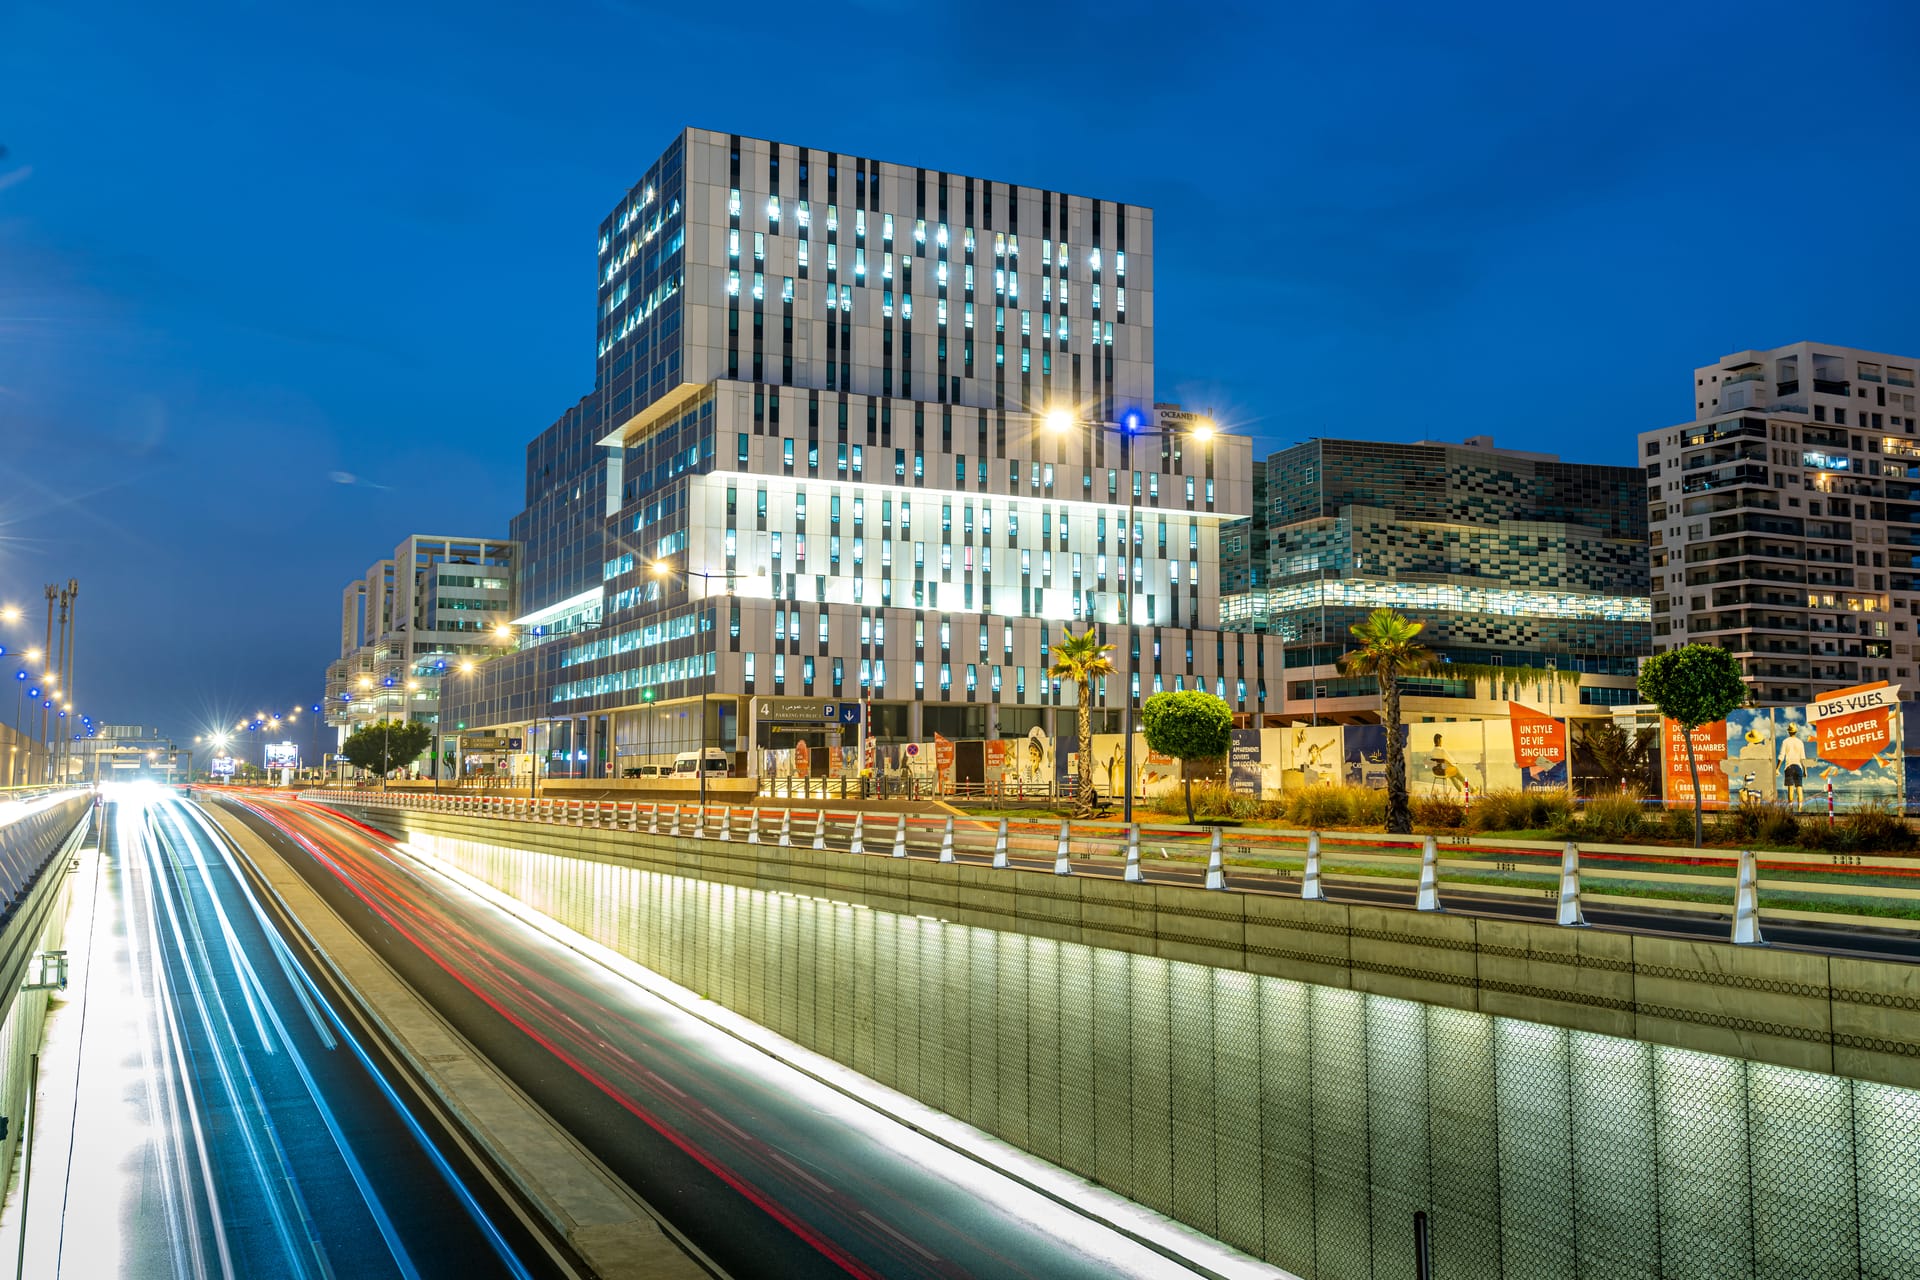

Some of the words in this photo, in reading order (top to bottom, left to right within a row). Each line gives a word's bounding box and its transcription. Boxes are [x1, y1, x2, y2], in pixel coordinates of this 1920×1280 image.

[1818, 701, 1844, 717] DES
[1847, 692, 1883, 710] VUES
[760, 704, 769, 716] 4
[826, 706, 833, 715] P
[1520, 725, 1530, 734] UN
[1532, 724, 1553, 734] STYLE
[1827, 728, 1834, 738] À
[1836, 720, 1878, 736] COUPER
[1520, 736, 1530, 745] DE
[1532, 736, 1544, 745] VIE
[1672, 733, 1711, 741] RÉCPTION
[1824, 741, 1837, 751] LE
[1839, 730, 1884, 748] SOUFFLE
[1686, 743, 1726, 752] HAMBRES
[1520, 748, 1559, 757] SINGULIER
[1674, 752, 1679, 761] À
